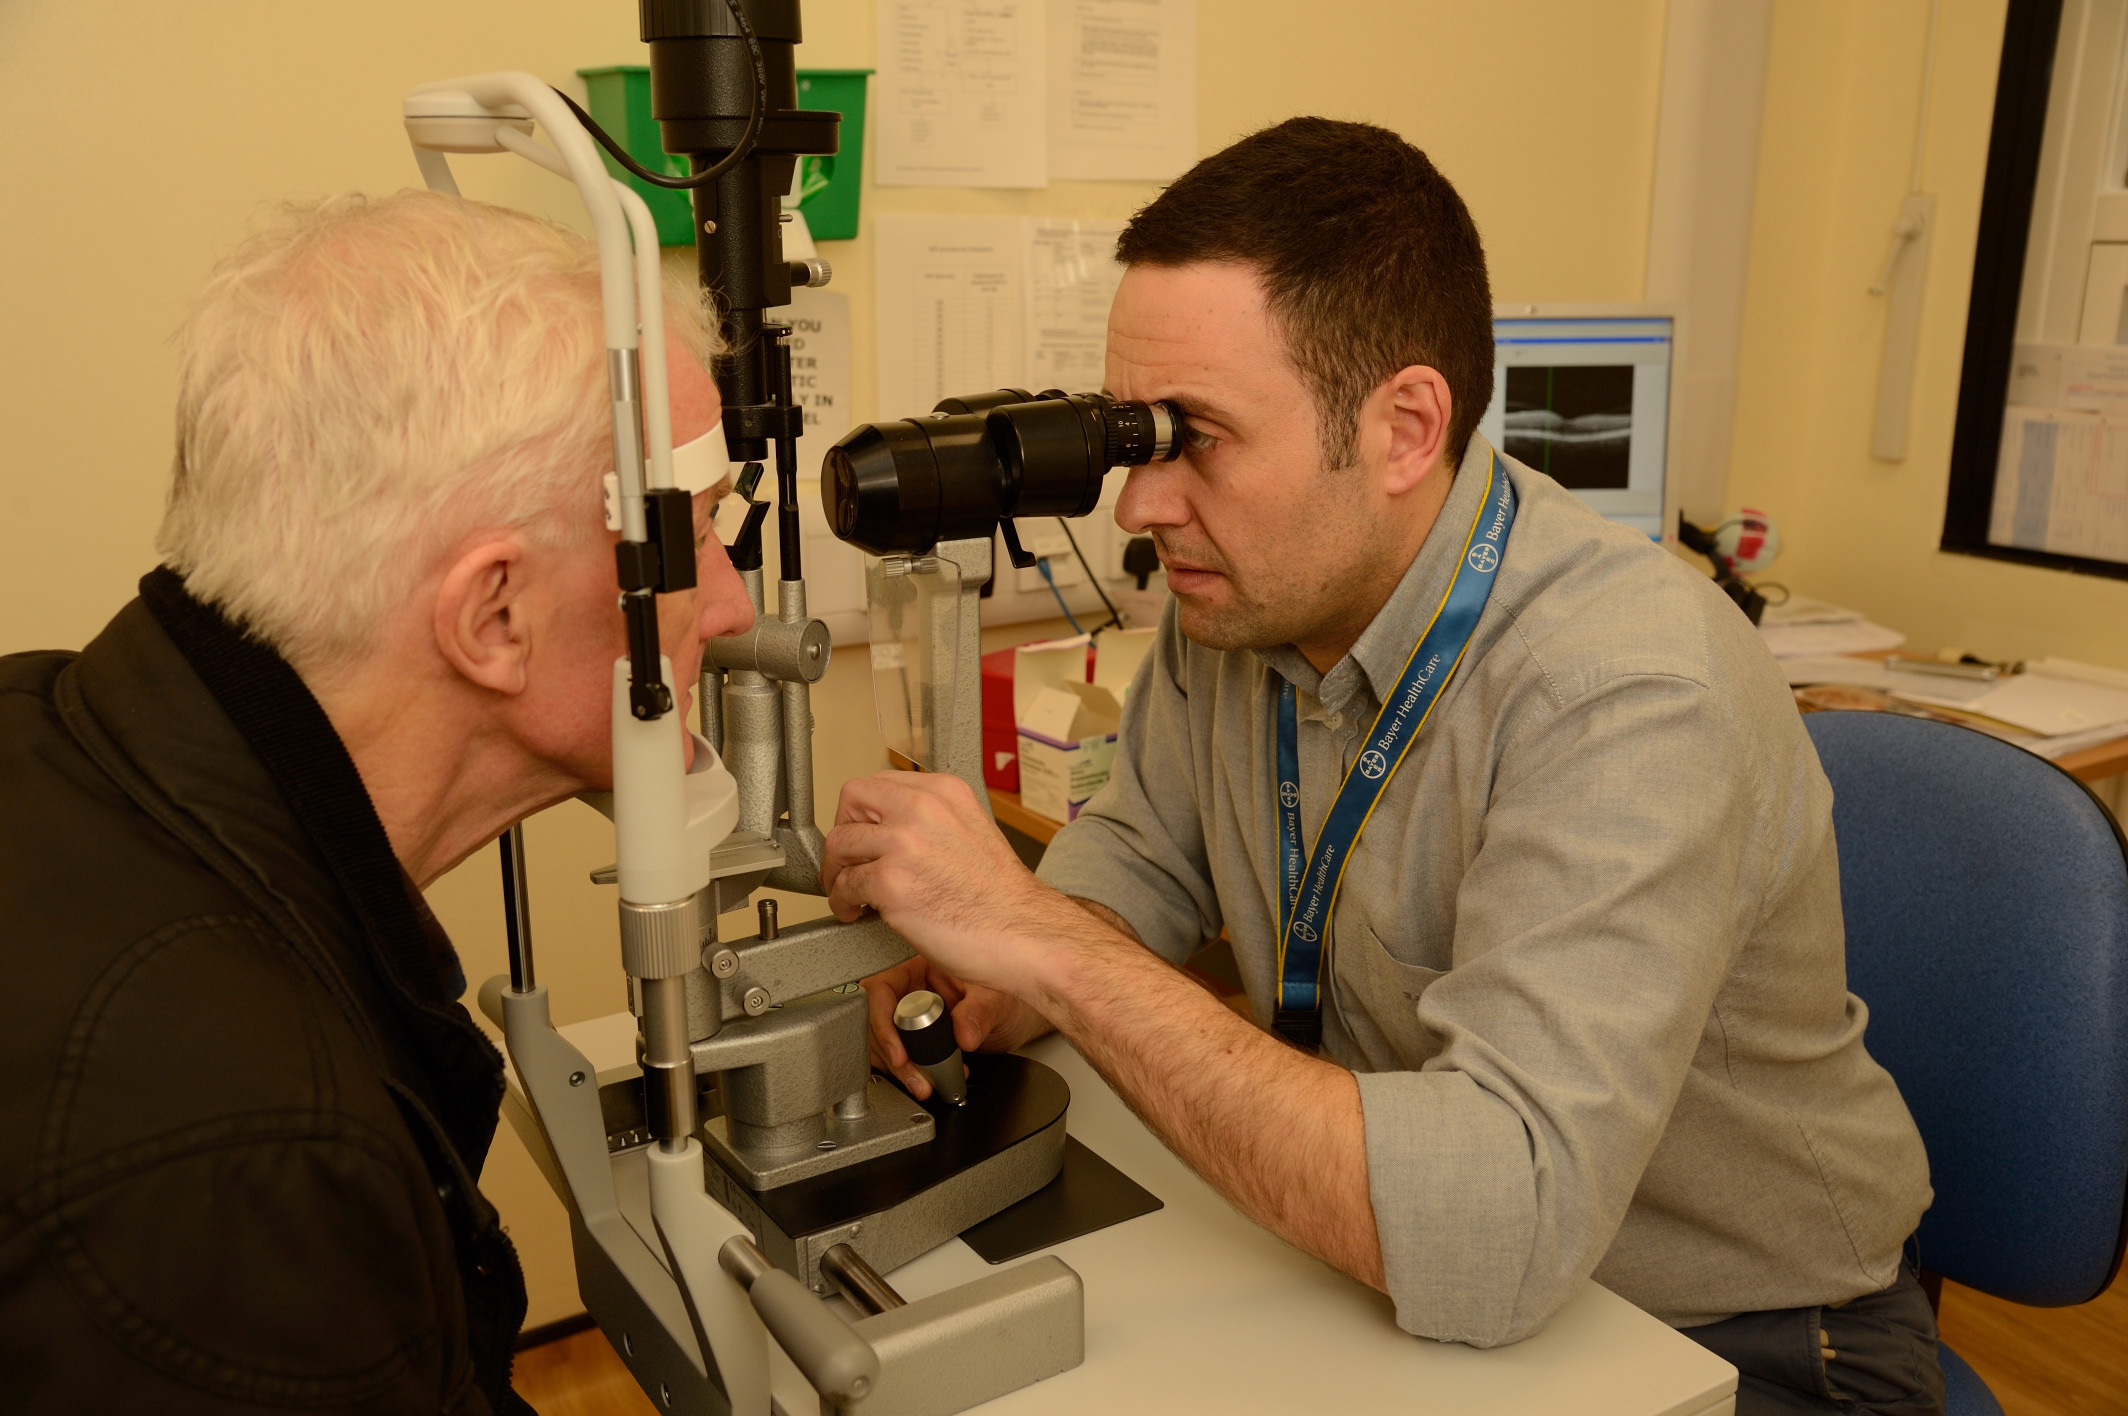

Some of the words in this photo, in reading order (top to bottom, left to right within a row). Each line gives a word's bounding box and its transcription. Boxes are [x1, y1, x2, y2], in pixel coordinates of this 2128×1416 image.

[1486, 508, 1506, 541] Bayer
[1378, 717, 1402, 751] Bayer
[1396, 653, 1441, 718] HealthCare
[1286, 812, 1297, 845] Bayer
[1302, 894, 1321, 923] Bayer
[1312, 844, 1335, 896] HealthCare
